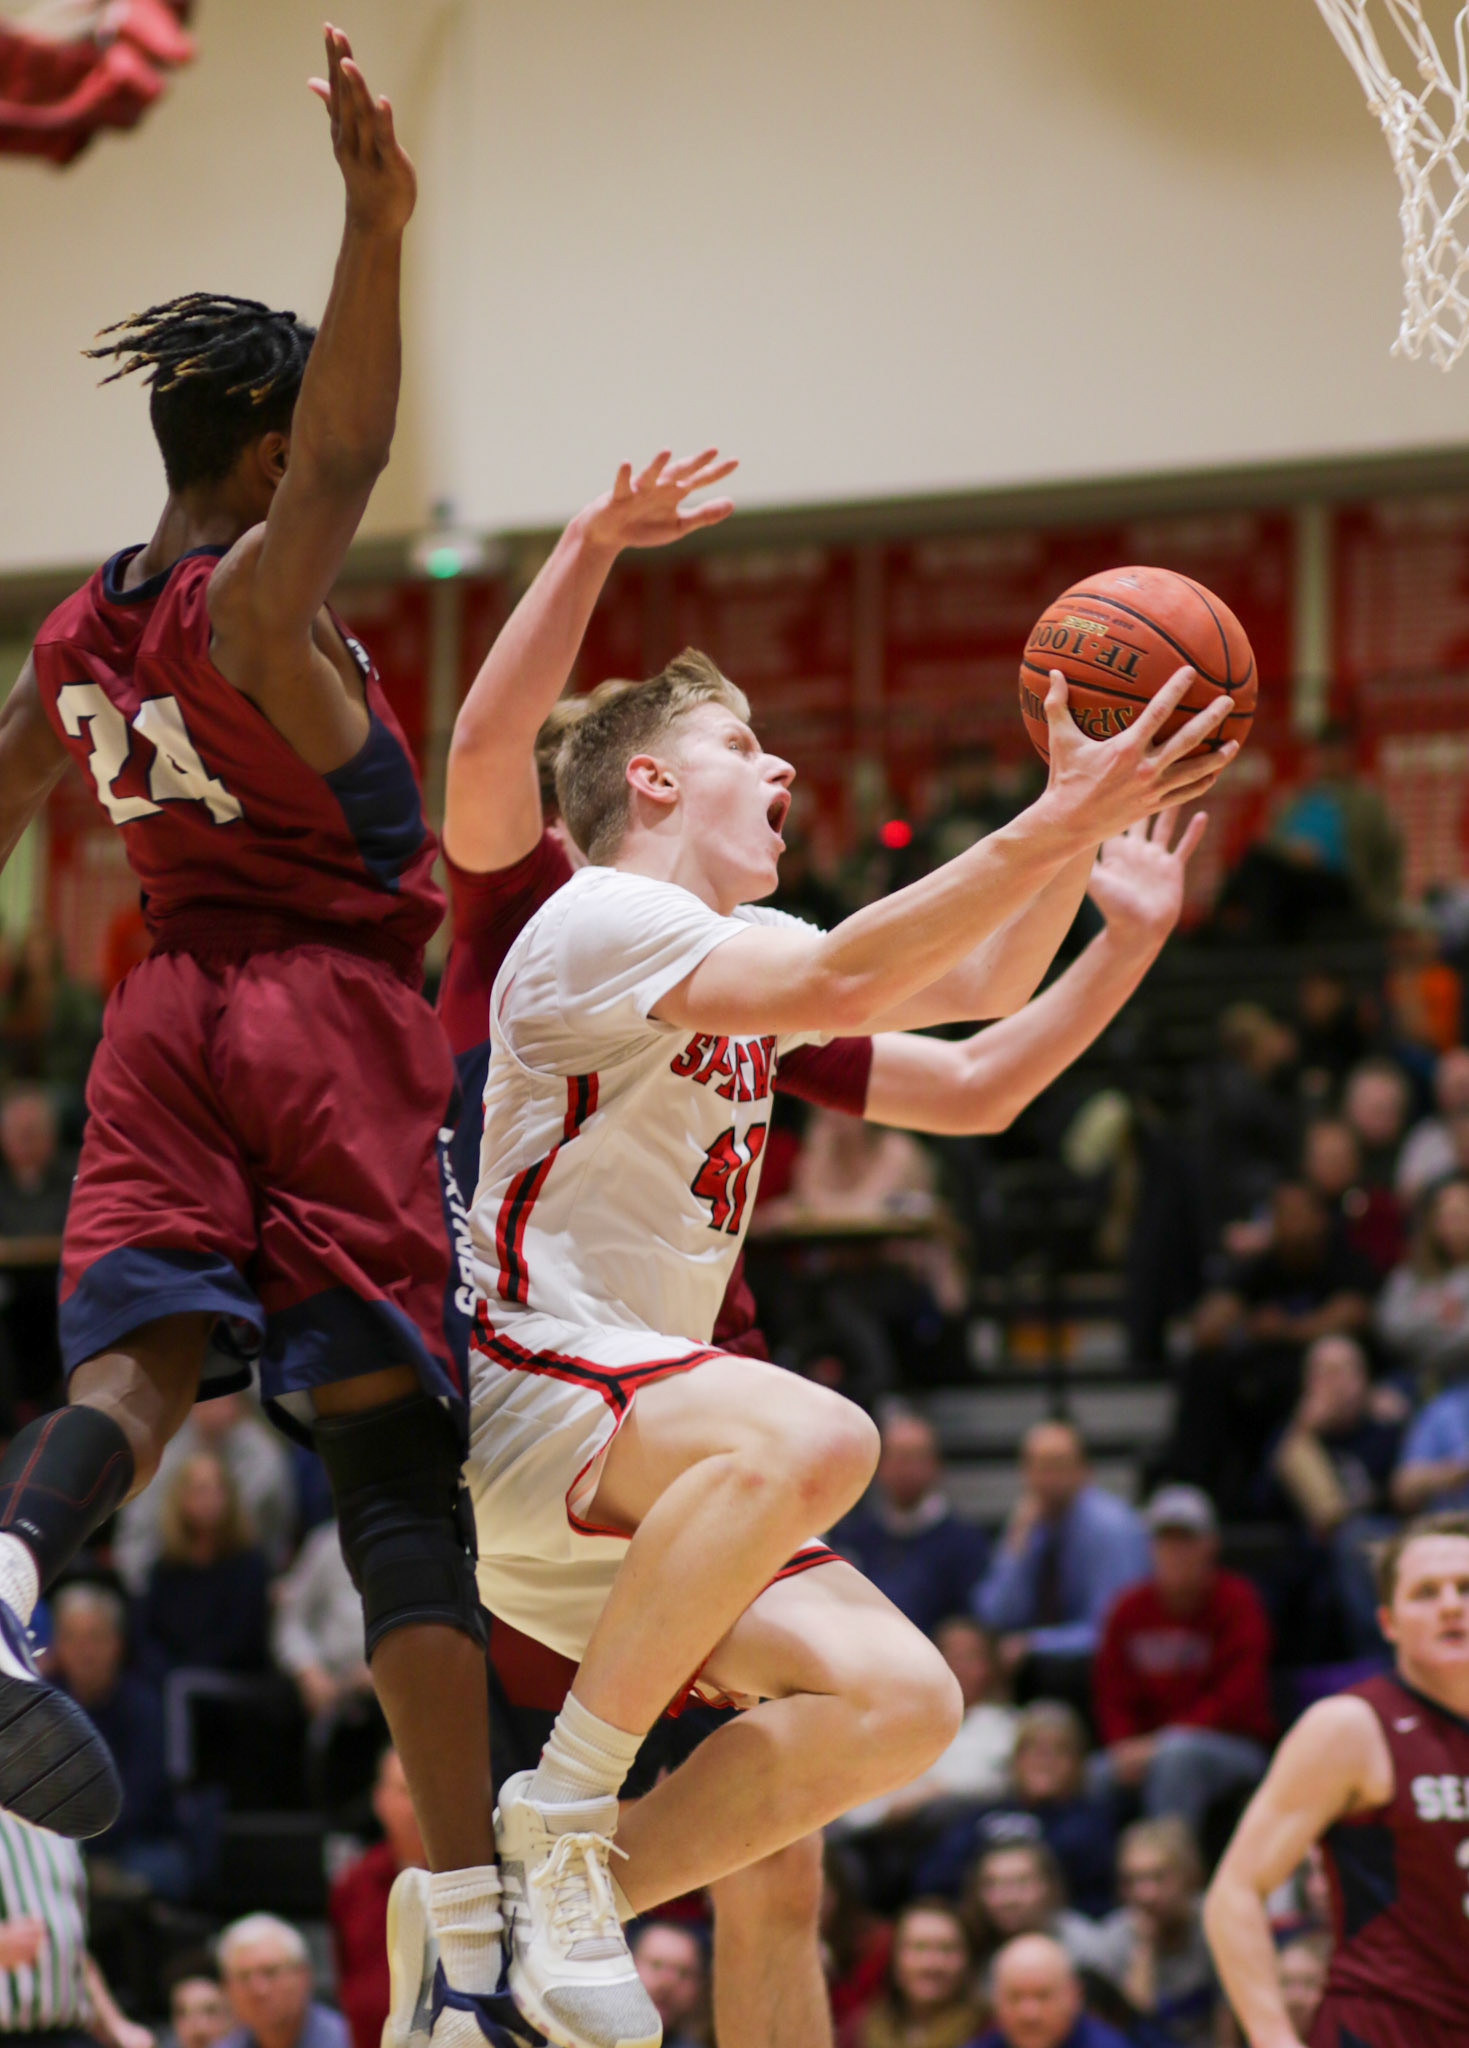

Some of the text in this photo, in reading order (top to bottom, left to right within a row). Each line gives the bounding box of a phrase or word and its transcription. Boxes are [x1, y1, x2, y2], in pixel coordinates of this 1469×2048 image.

[56, 681, 243, 826] 24
[1020, 685, 1132, 736] SPAIN
[670, 1032, 777, 1102] SAIN
[691, 1122, 766, 1235] 41
